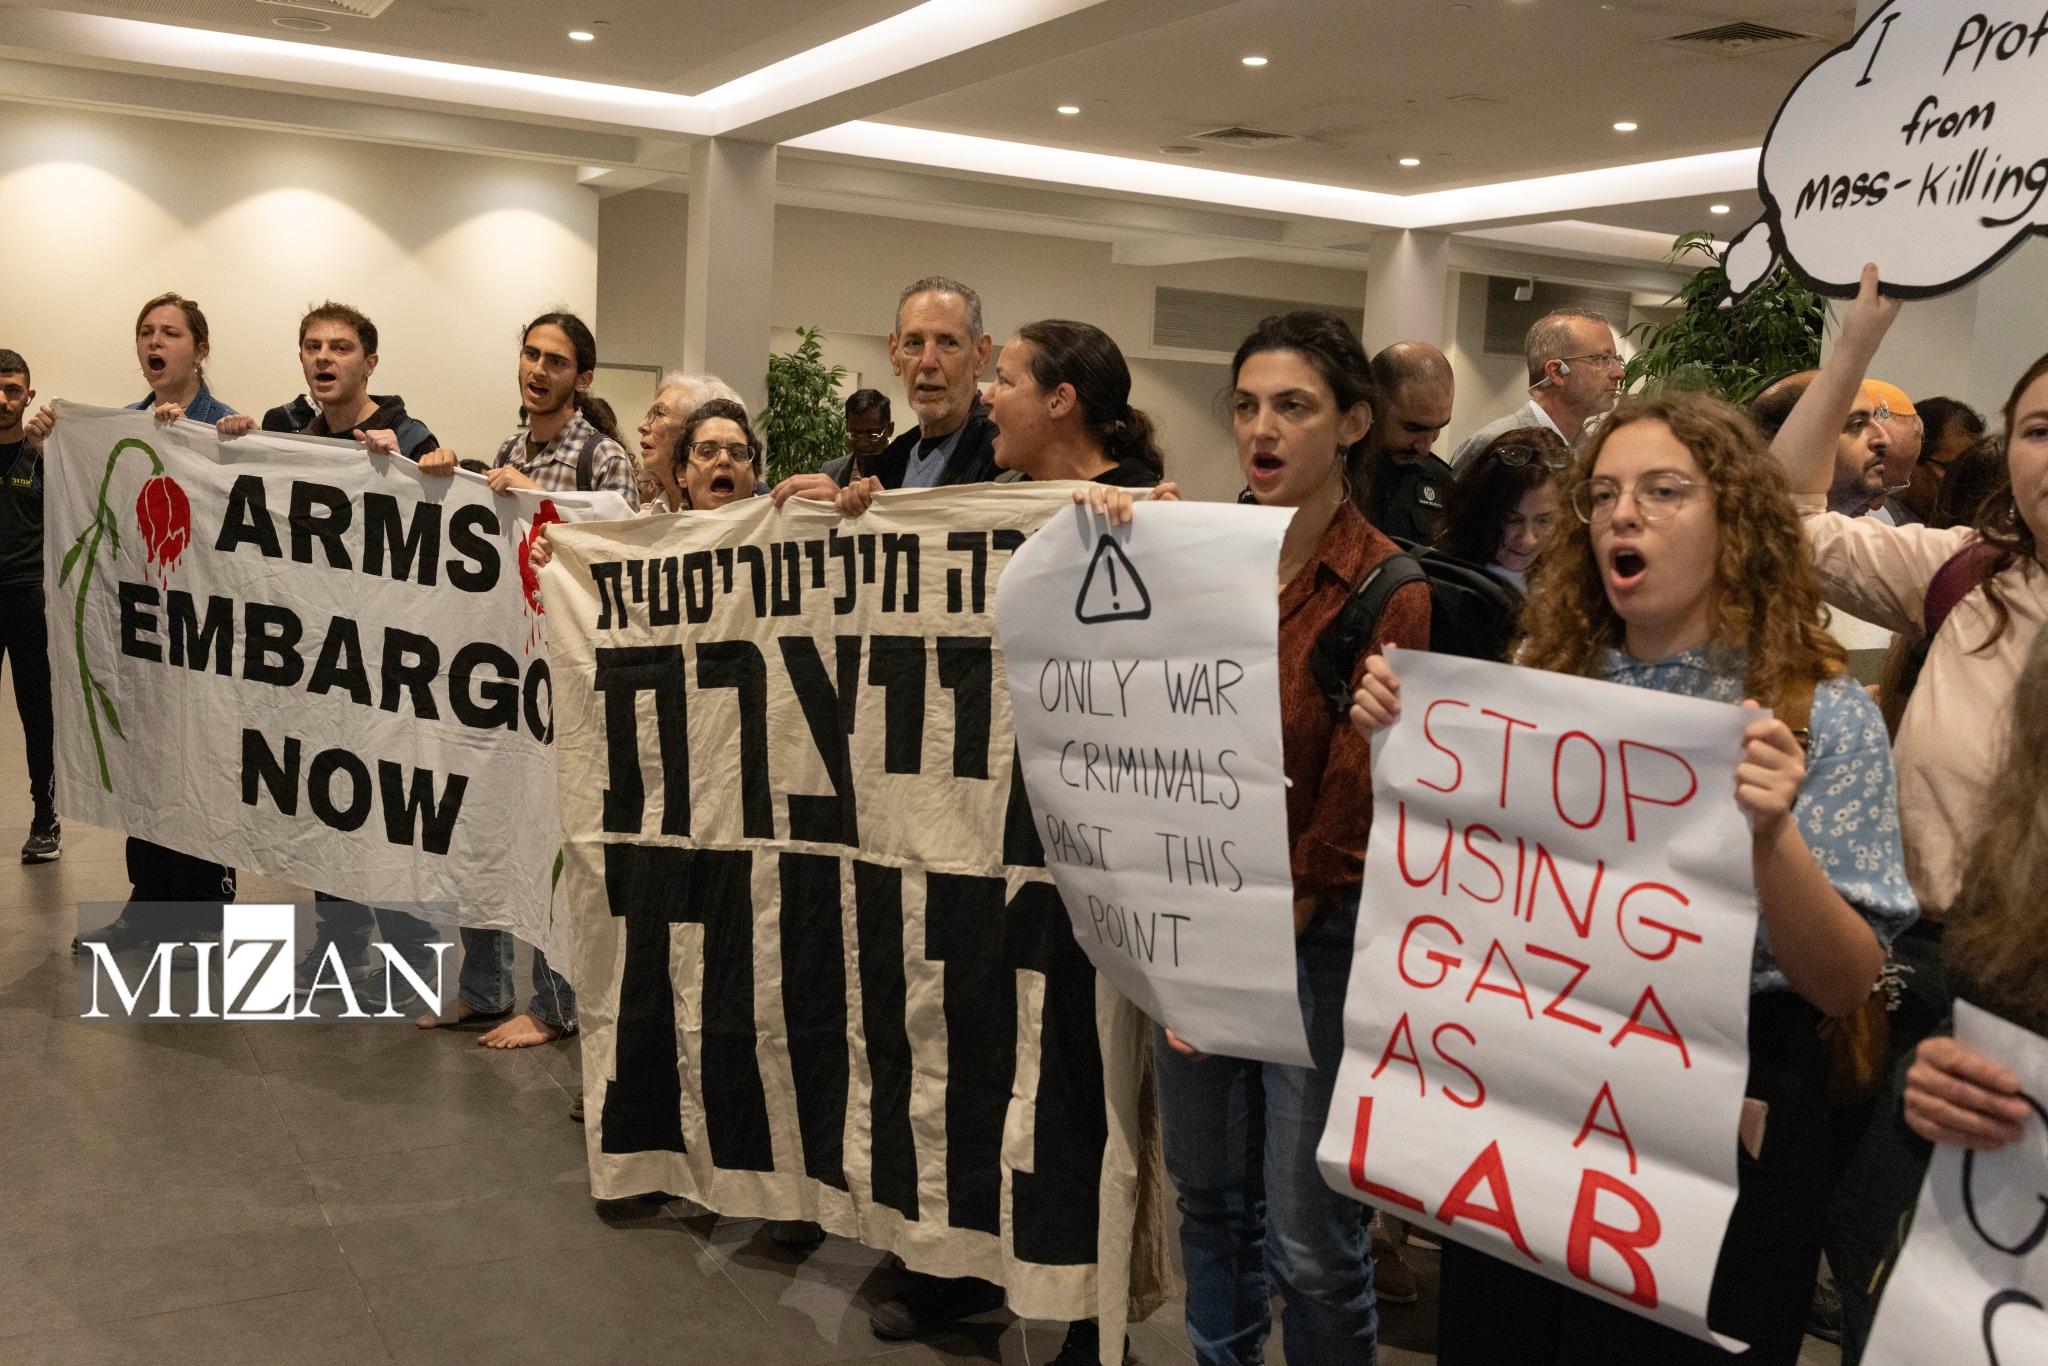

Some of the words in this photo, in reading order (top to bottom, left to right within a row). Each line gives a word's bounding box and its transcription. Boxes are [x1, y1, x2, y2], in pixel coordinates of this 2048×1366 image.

[1855, 11, 1902, 87] I
[1901, 95, 1996, 146] from
[214, 474, 500, 593] ARMS
[589, 528, 920, 630] מיליטריסטית
[118, 580, 554, 746] EMBARGO
[1039, 658, 1140, 717] ONLY
[1163, 659, 1245, 716] WAR
[241, 728, 469, 856] NOW
[594, 634, 1046, 866] ייצרת
[1059, 740, 1240, 811] CRIMINALS
[1417, 699, 1697, 842] STOP
[1046, 814, 1113, 872] PAST
[1154, 832, 1243, 892] THIS
[1397, 801, 1702, 961] USING
[1088, 894, 1191, 967] POINT
[1397, 914, 1691, 1069] GAZA
[1371, 1011, 1486, 1109] AS
[1572, 1081, 1638, 1175] A
[1349, 1096, 1662, 1310] LAB
